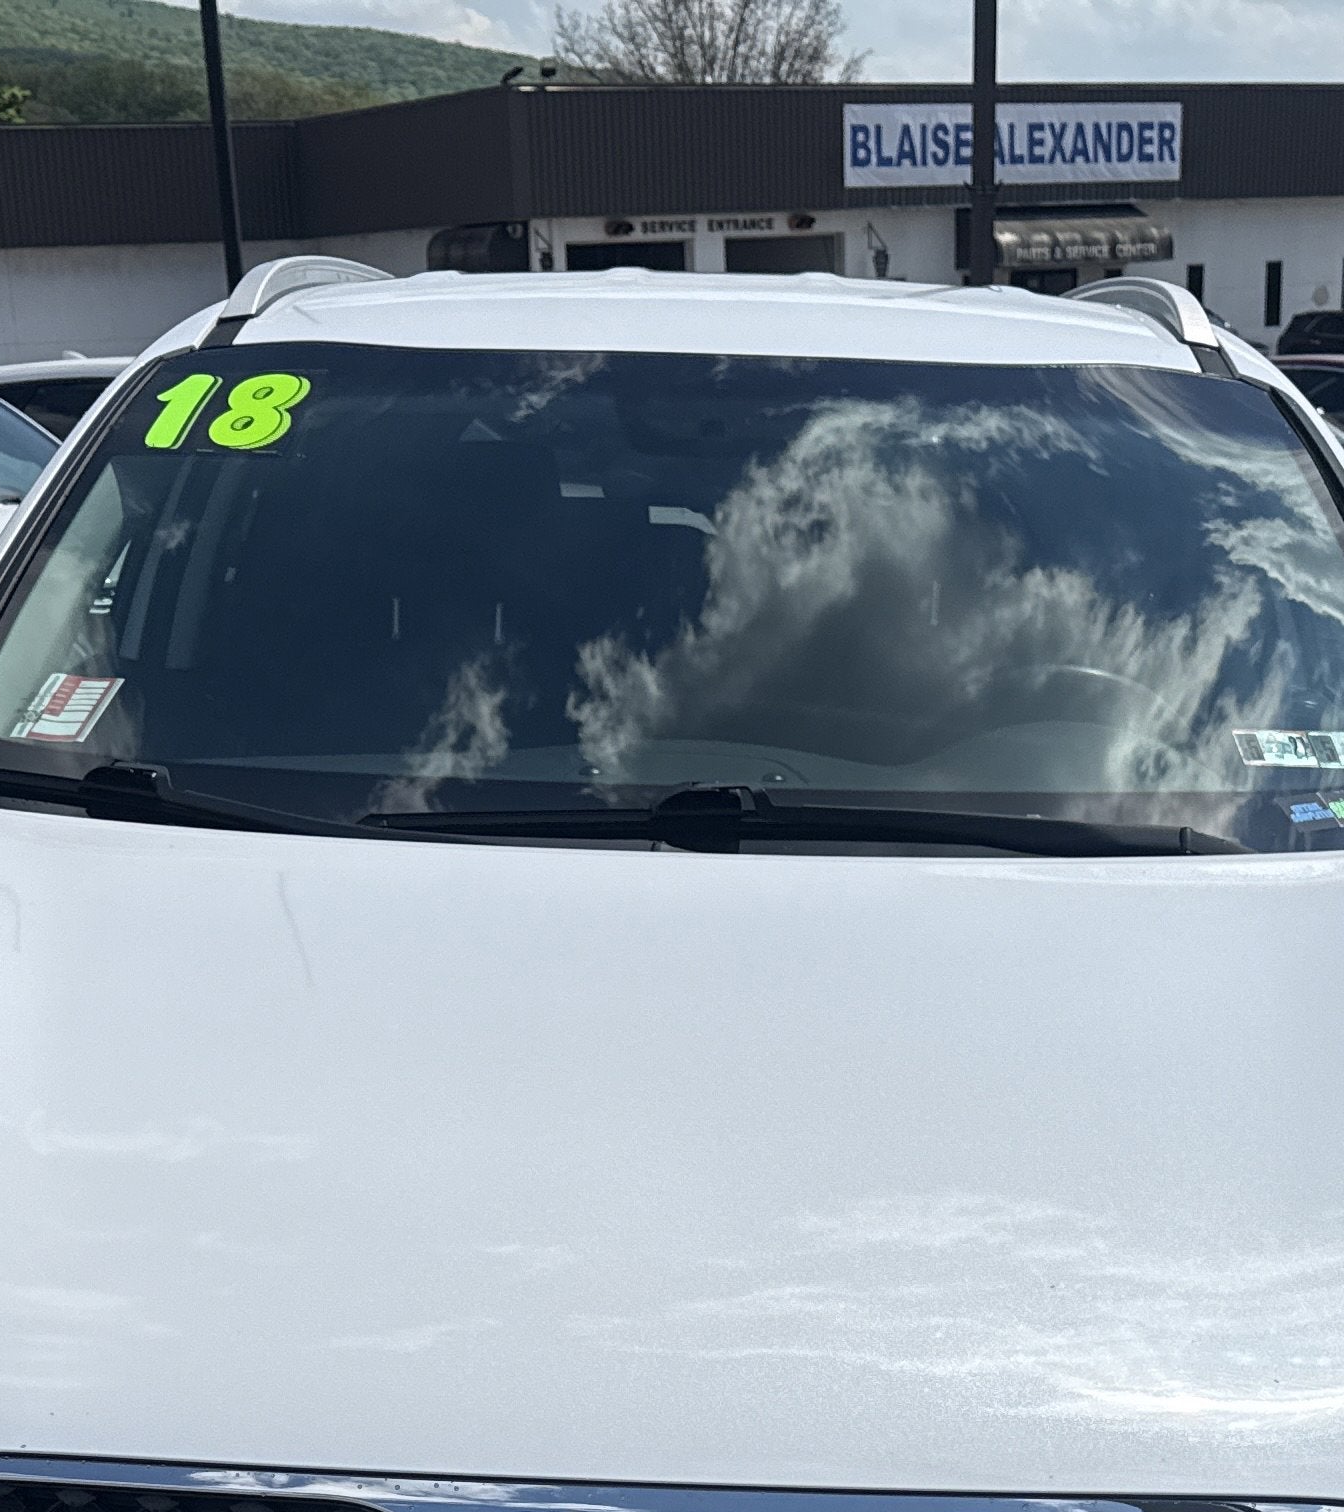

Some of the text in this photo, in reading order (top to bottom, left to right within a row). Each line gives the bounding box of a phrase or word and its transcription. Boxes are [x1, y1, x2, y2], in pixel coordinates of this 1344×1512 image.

[849, 122, 973, 168] BLAISE
[640, 217, 774, 234] SERVICE ENTRANCE
[144, 372, 312, 451] 18
